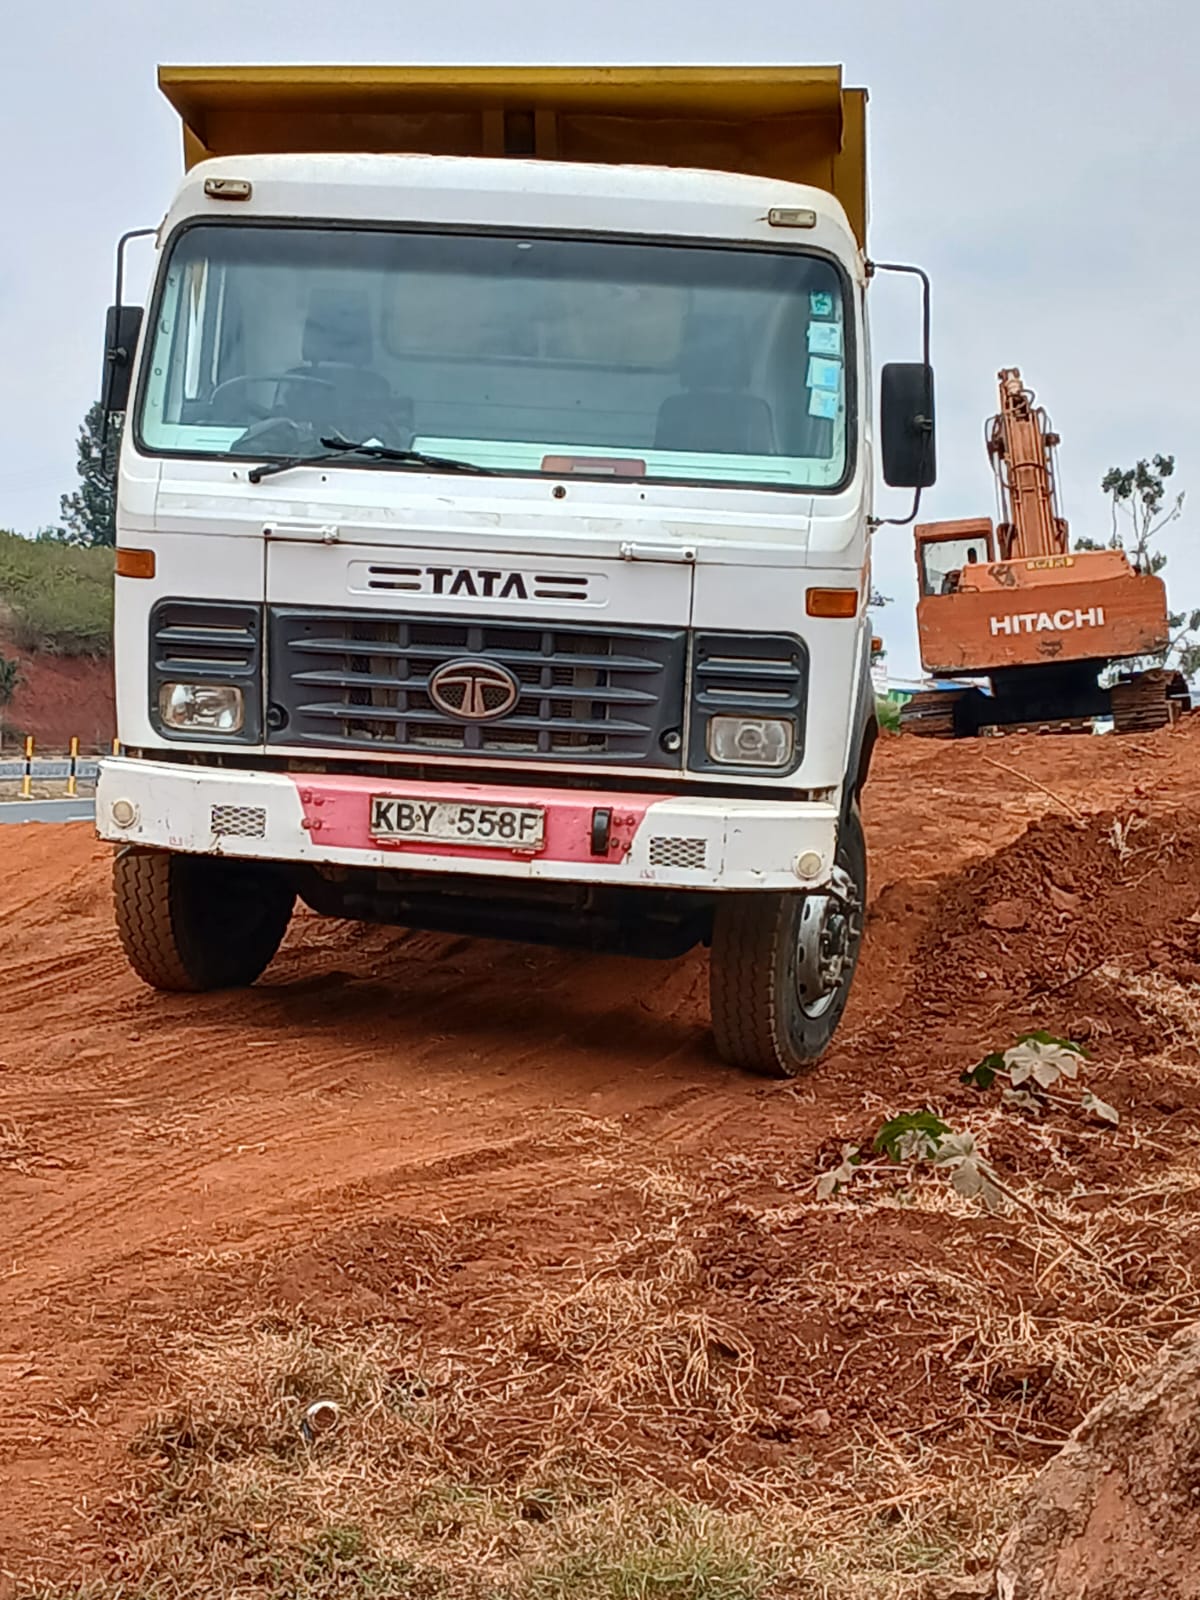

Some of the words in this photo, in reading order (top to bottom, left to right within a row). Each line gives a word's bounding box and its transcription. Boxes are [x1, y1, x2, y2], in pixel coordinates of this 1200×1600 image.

[426, 567, 528, 599] TATA
[990, 607, 1105, 635] HITACHI
[373, 801, 437, 832] KBY
[456, 808, 538, 839] 558F
